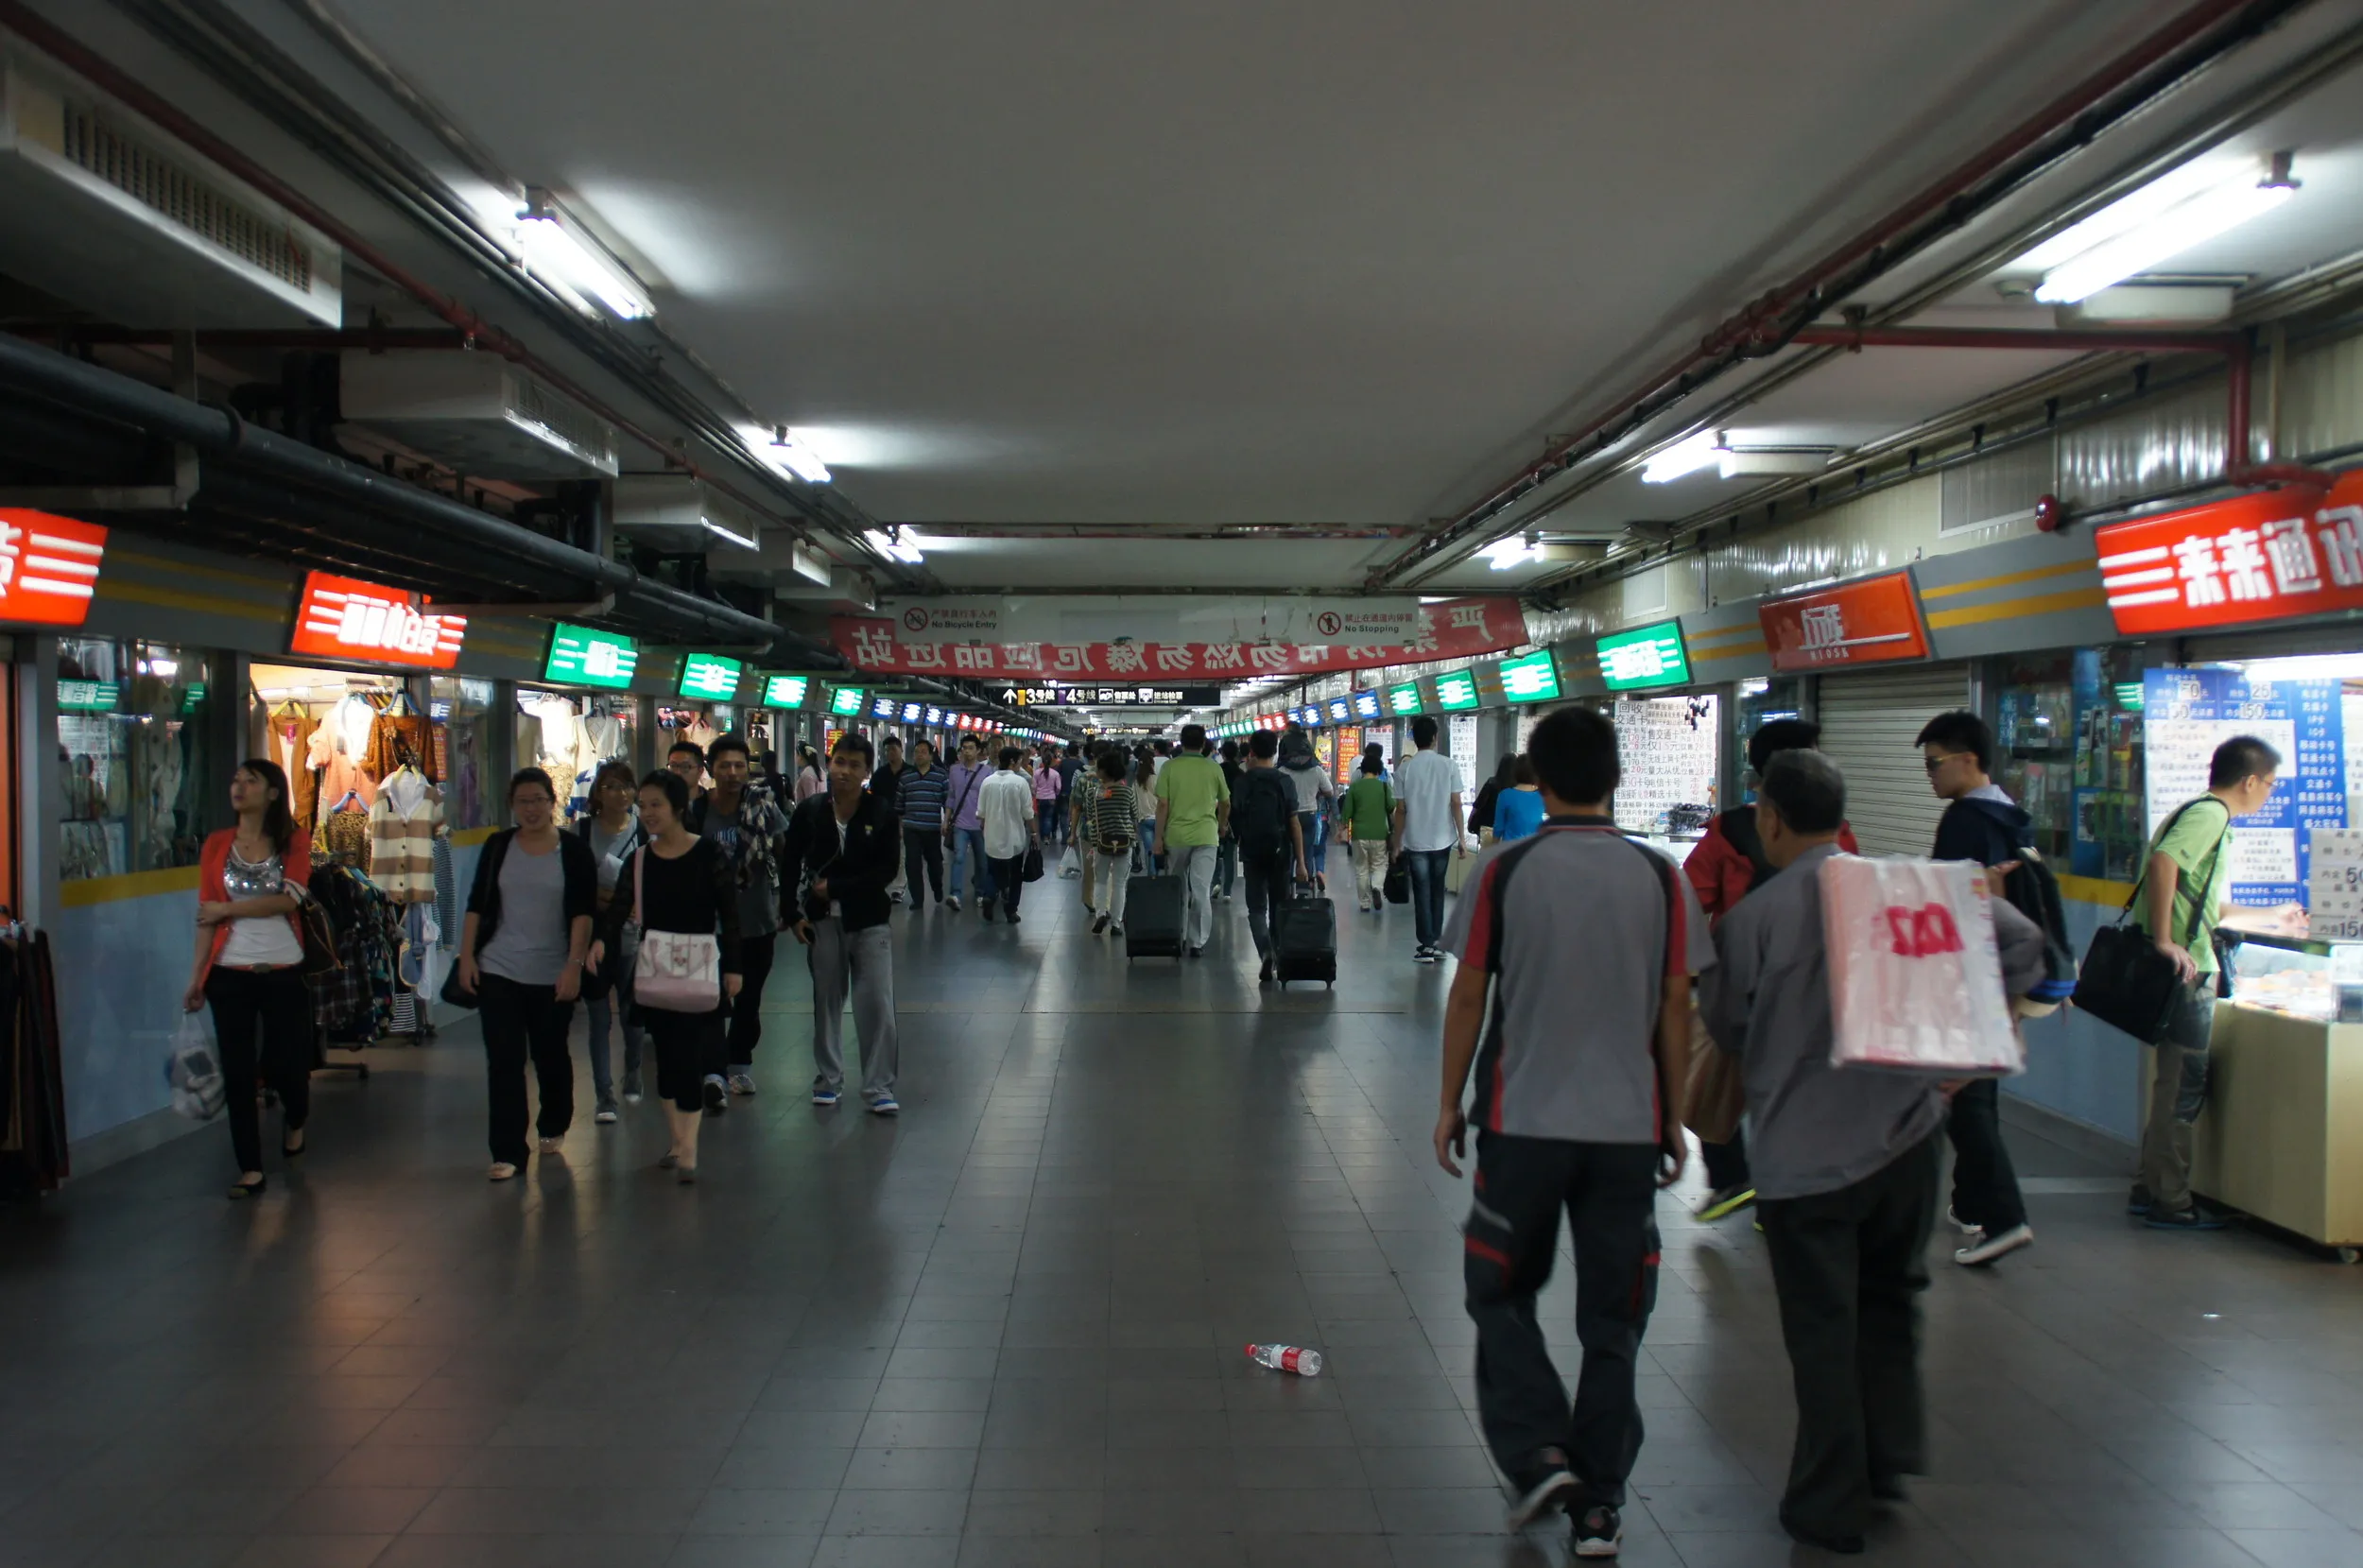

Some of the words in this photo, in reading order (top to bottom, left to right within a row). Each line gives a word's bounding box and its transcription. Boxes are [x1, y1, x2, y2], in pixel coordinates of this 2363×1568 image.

[932, 620, 943, 629] No
[945, 620, 974, 629] Bicycle
[975, 620, 997, 629] Entry
[1359, 624, 1399, 633] Stopping
[1619, 702, 1643, 714] 回收
[1615, 714, 1647, 726] 交通卡
